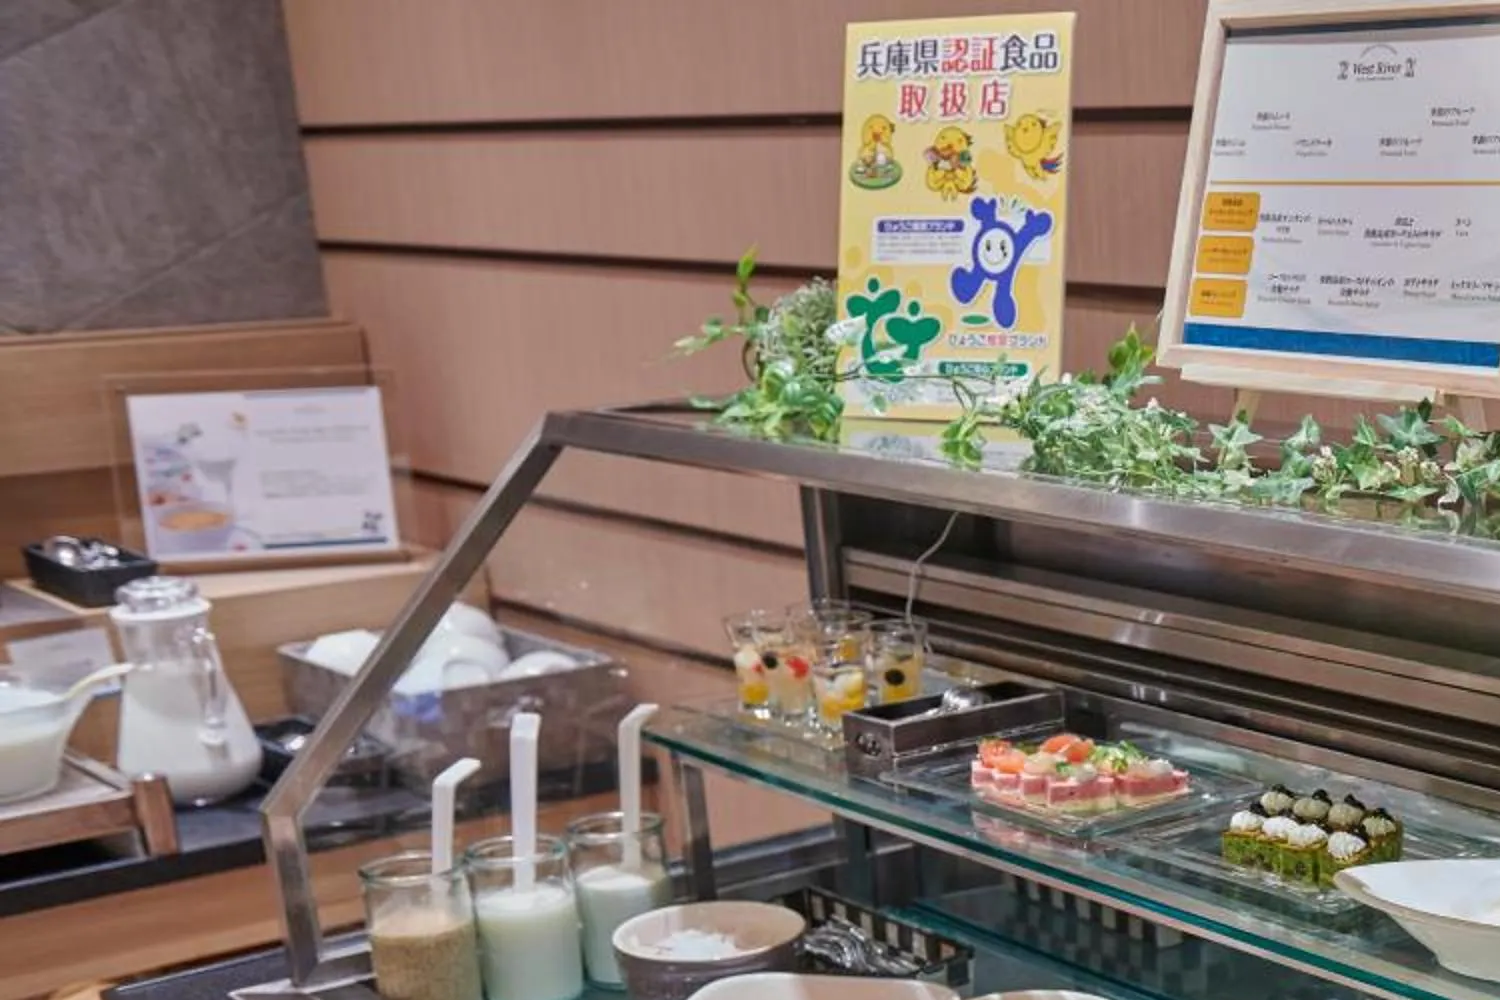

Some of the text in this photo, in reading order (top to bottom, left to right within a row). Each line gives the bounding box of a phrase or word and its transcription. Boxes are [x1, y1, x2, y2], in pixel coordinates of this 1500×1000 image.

[857, 32, 1058, 77] 兵庫県認証食品
[899, 80, 1009, 117] 取扱店
